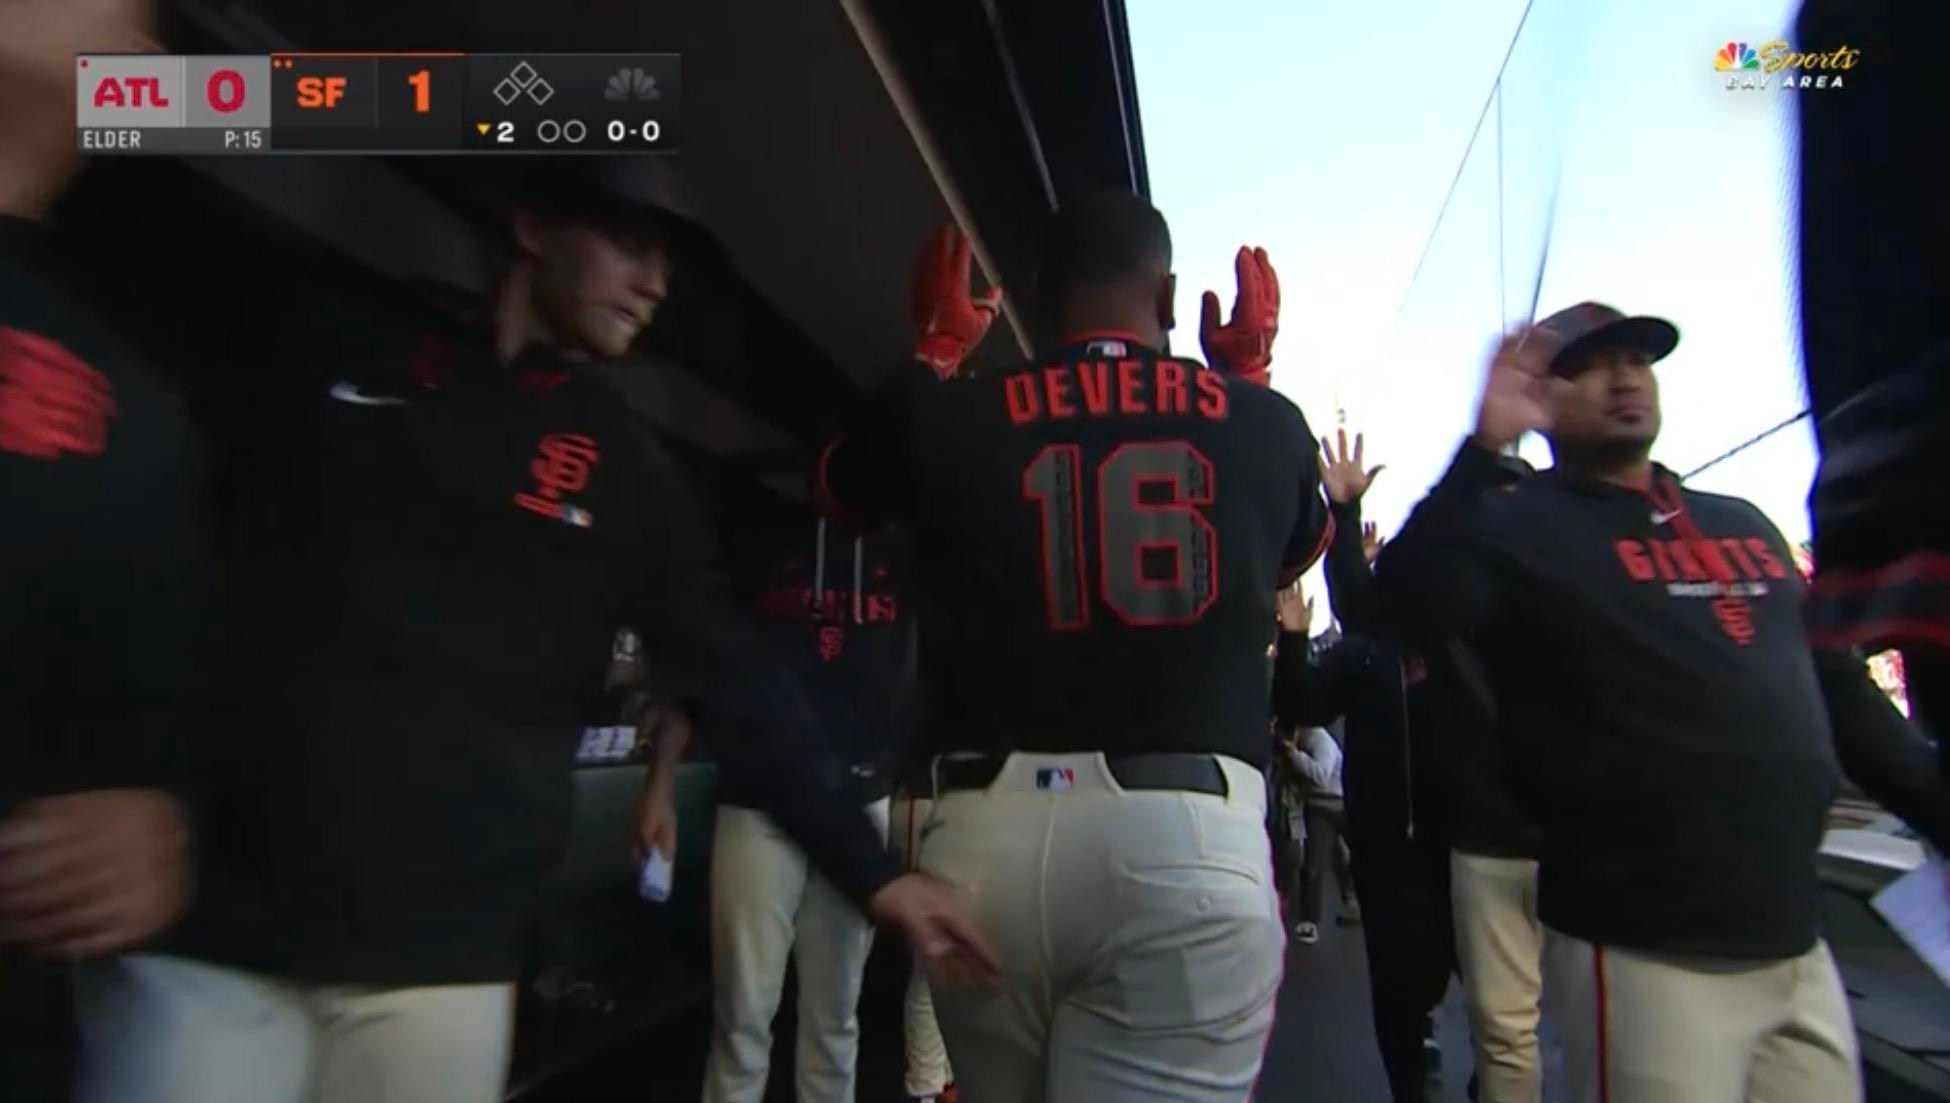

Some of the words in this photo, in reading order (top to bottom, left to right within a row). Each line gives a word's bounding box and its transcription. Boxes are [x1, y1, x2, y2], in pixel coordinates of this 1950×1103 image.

[1004, 358, 1229, 425] DEVERS
[1022, 439, 1219, 631] 16
[1615, 537, 1788, 582] GIANTS
